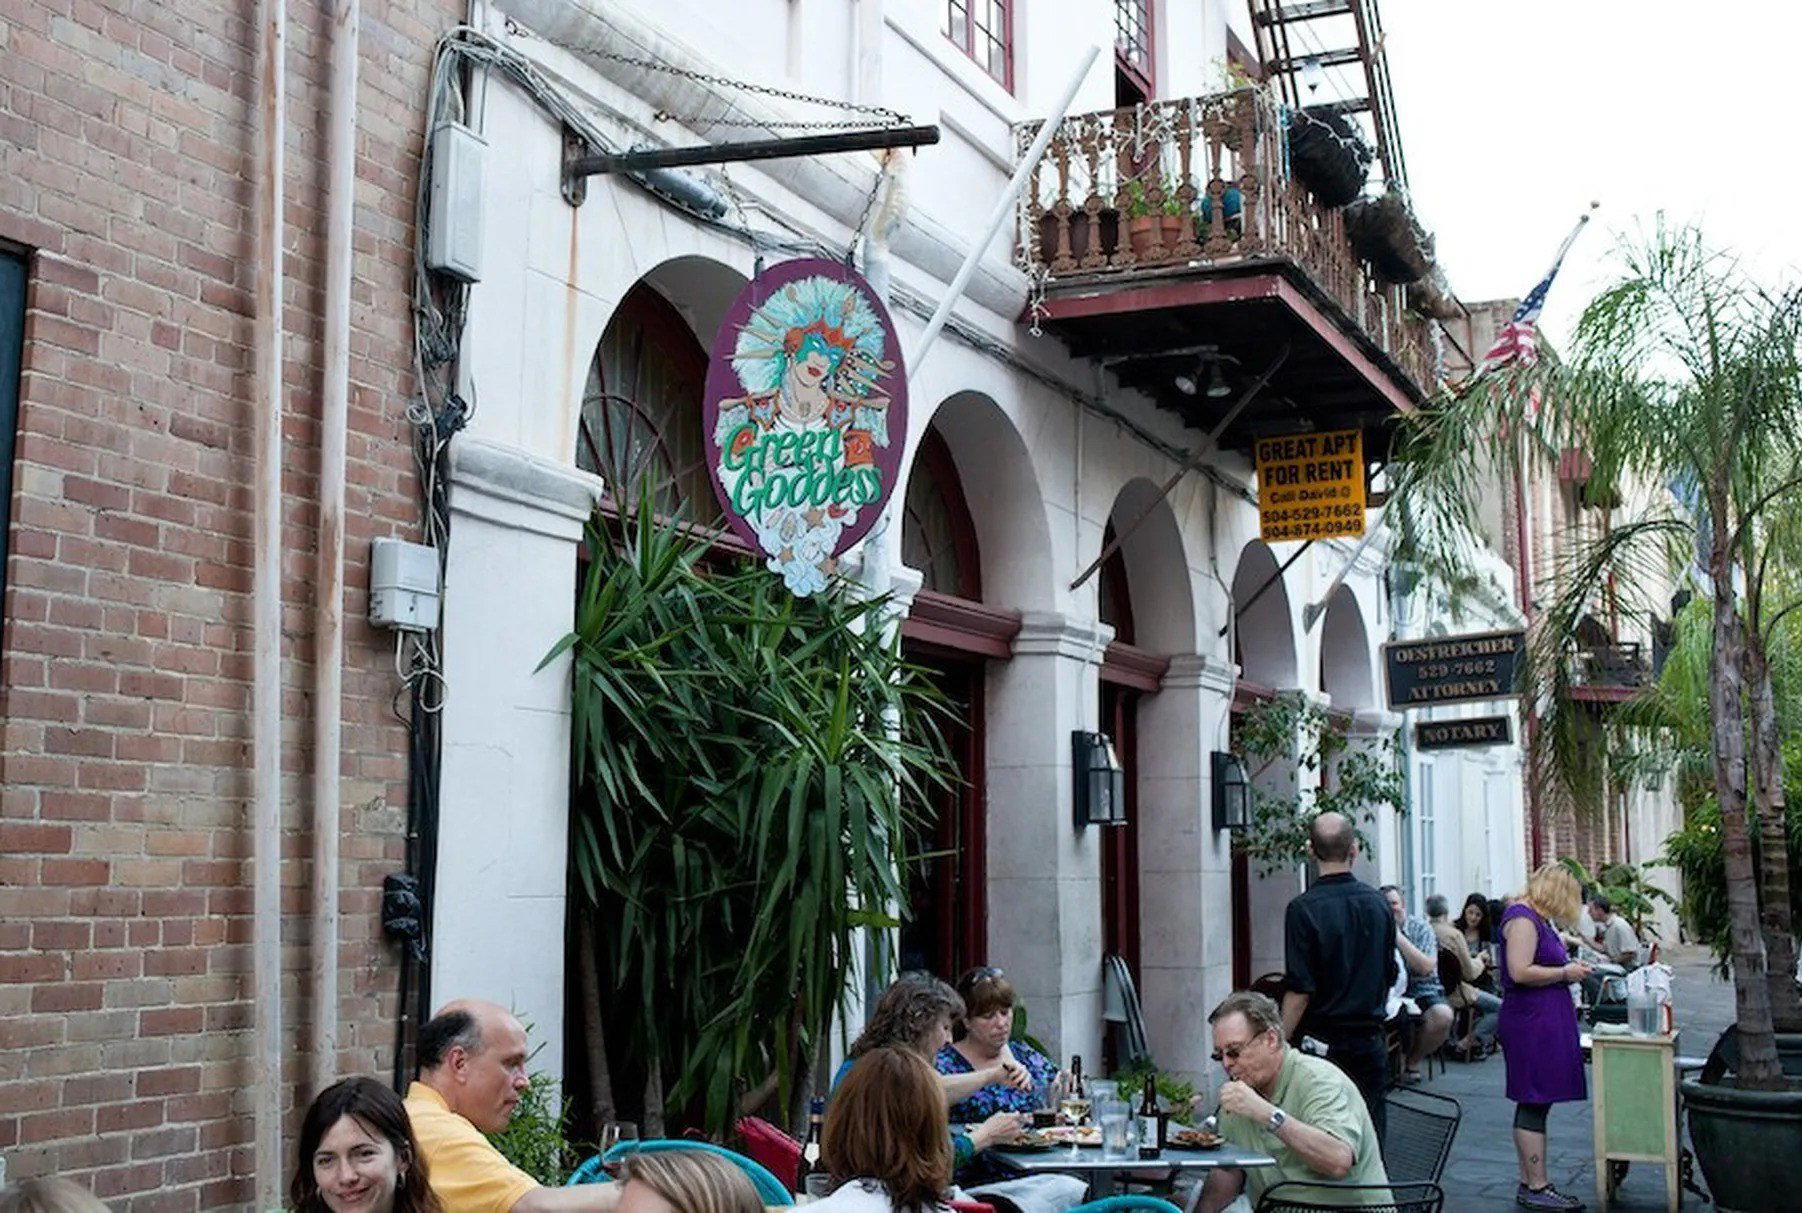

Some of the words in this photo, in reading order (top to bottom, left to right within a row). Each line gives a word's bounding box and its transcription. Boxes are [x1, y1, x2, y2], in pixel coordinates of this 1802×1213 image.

[723, 422, 842, 474] Green
[1260, 439, 1317, 462] GREAT
[1322, 434, 1358, 456] APT
[1264, 465, 1300, 487] FOR
[1306, 460, 1354, 483] RENT
[733, 452, 883, 524] Goddess
[1409, 679, 1499, 700] ATTORNEY
[1424, 722, 1501, 743] NOTARY
